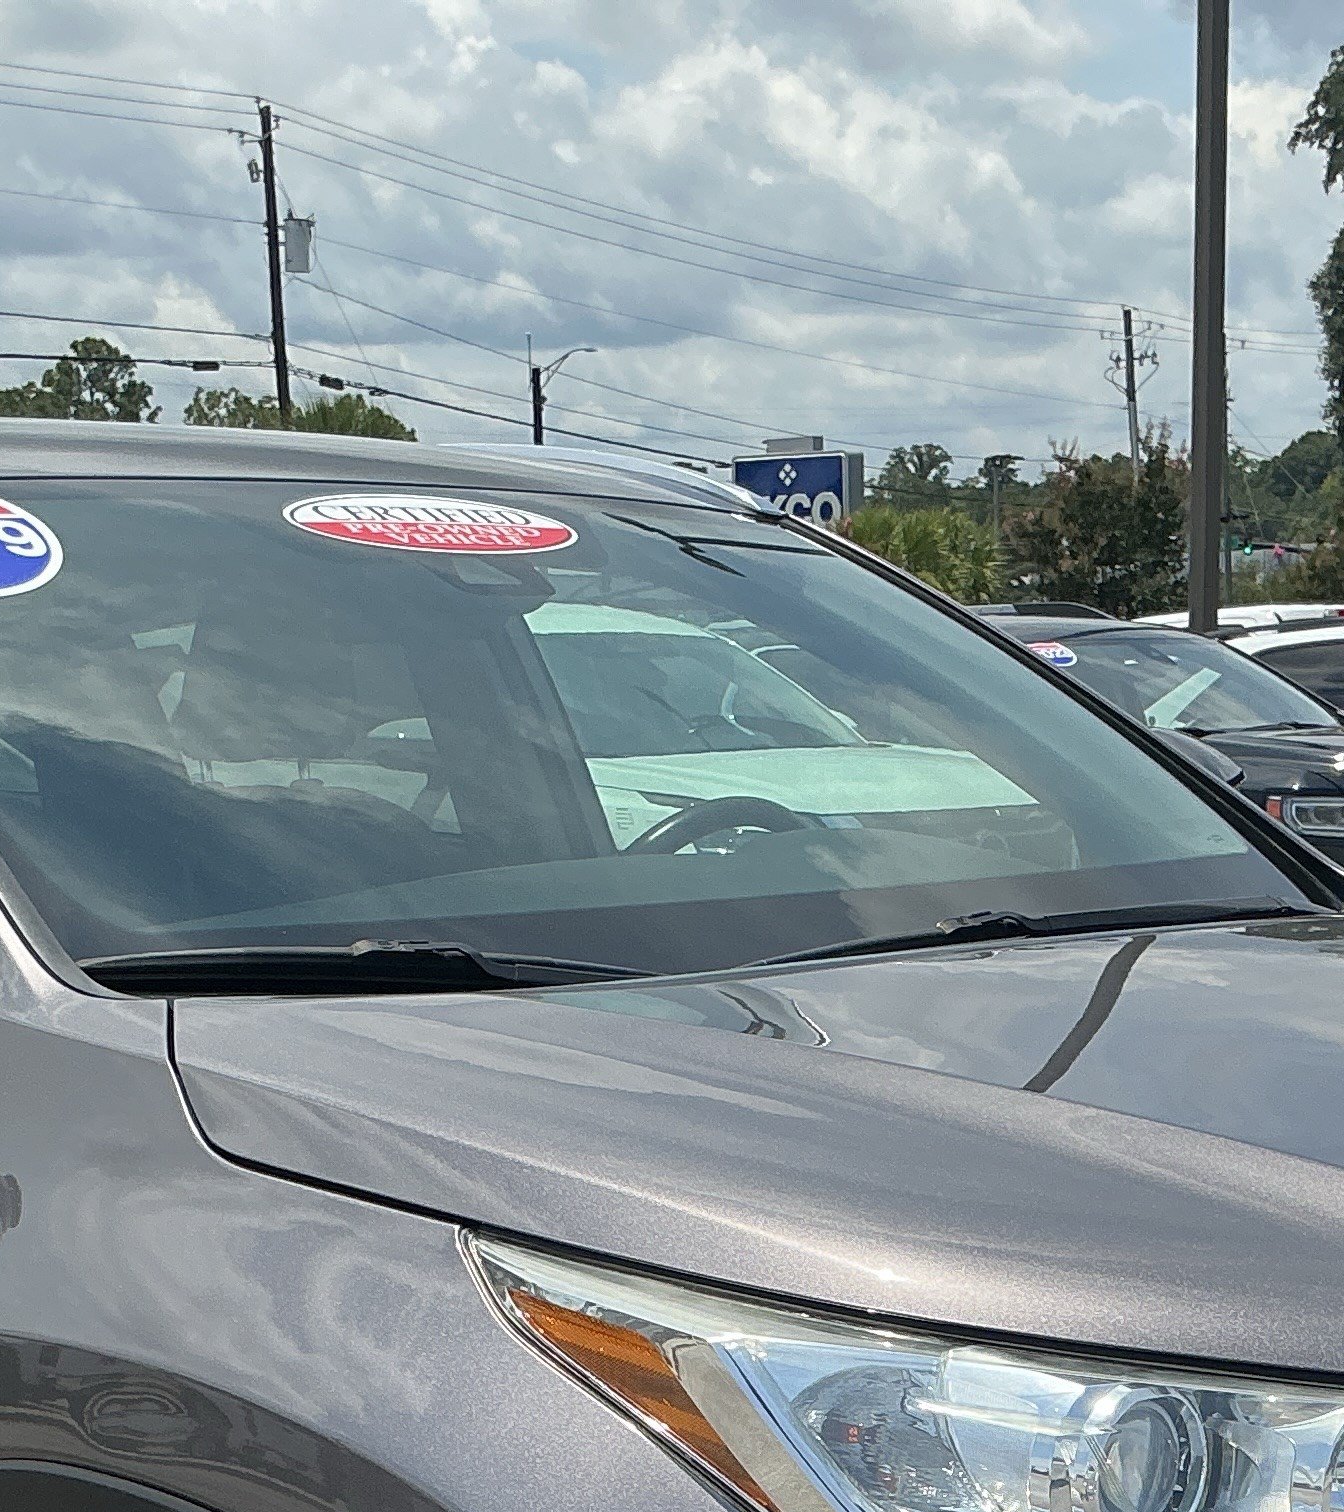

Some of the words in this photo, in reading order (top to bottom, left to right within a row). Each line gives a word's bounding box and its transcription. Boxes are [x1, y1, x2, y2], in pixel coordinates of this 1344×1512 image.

[312, 505, 532, 526] CERTIFIED
[342, 522, 541, 538] PRE-OWNED
[393, 533, 532, 547] VEHICLE
